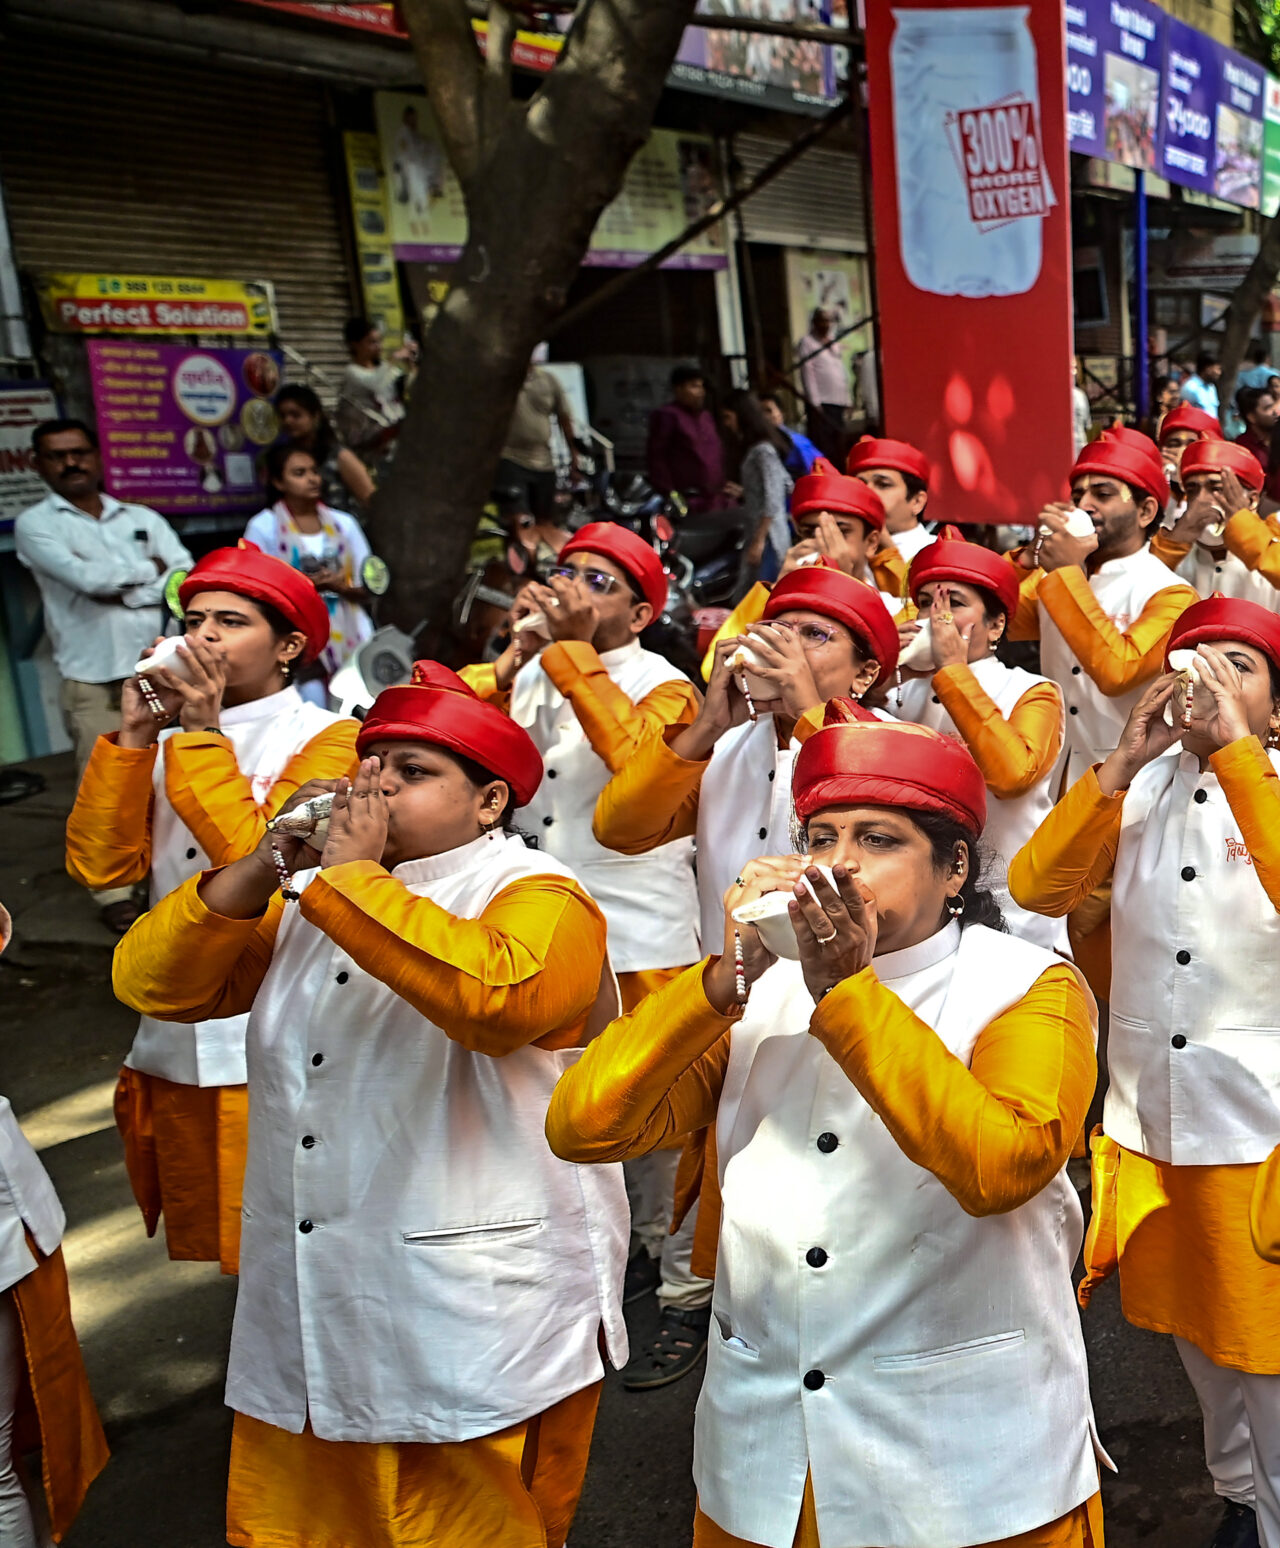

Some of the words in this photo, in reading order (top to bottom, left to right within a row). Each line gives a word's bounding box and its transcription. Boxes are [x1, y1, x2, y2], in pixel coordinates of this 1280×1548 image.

[962, 105, 1039, 176] 300%
[970, 171, 1040, 191] MORE
[971, 184, 1044, 219] OXYGEN
[61, 301, 150, 325] Perfect
[156, 302, 245, 327] Solution
